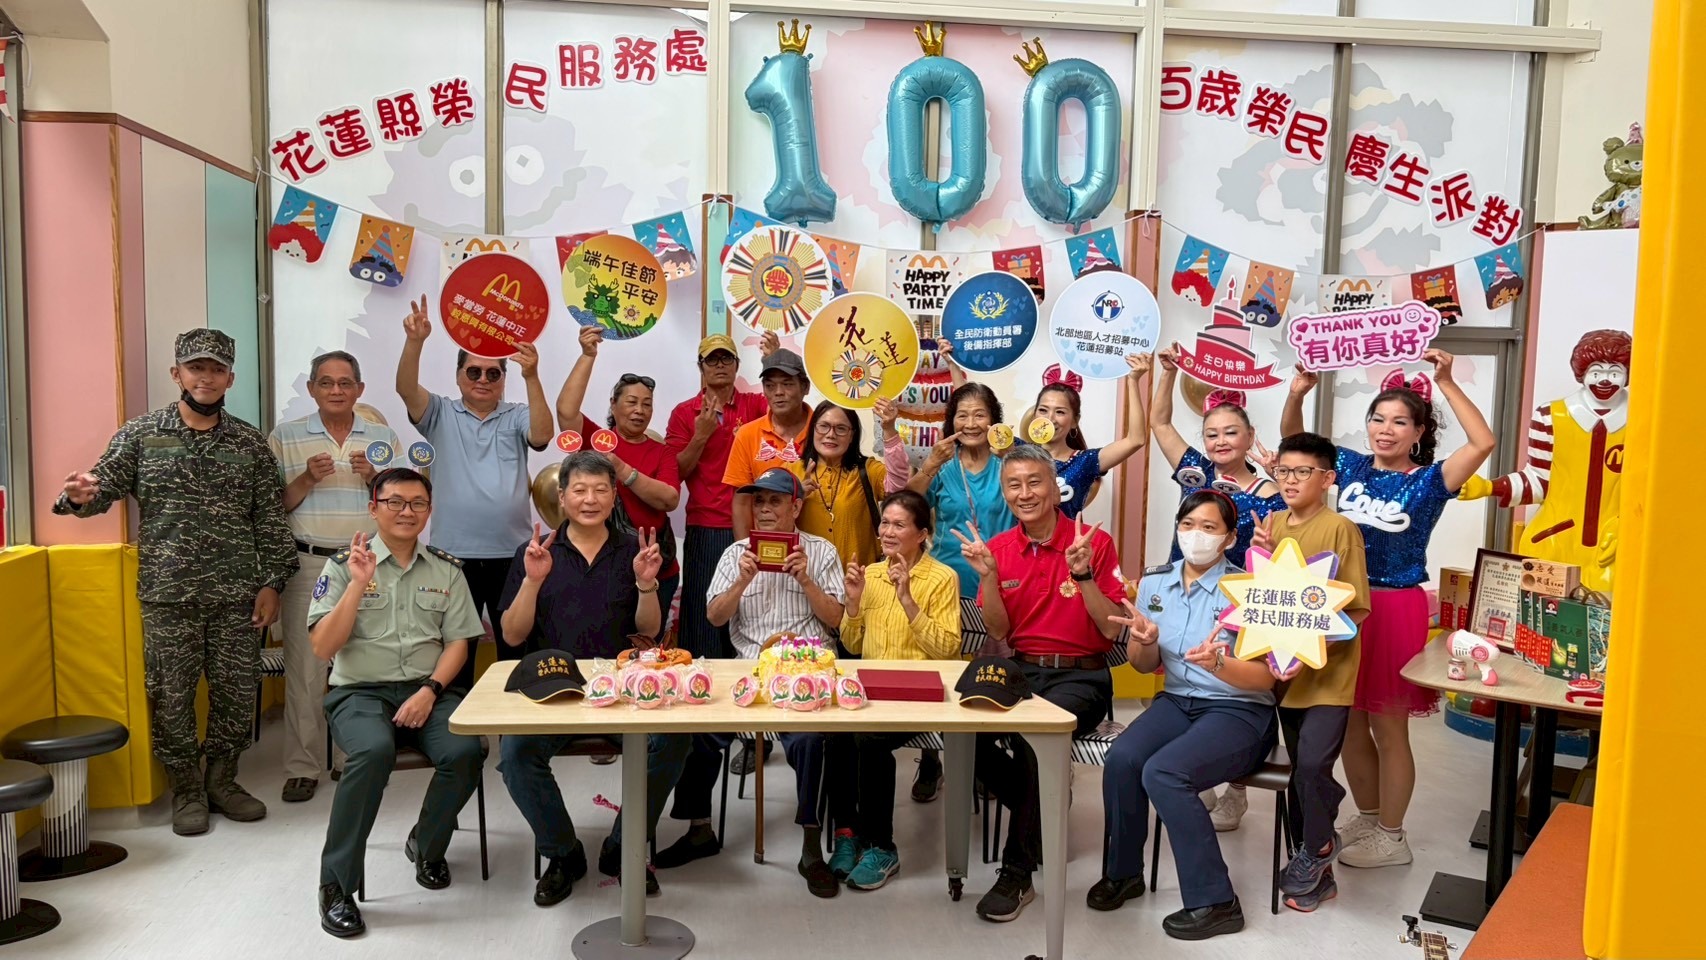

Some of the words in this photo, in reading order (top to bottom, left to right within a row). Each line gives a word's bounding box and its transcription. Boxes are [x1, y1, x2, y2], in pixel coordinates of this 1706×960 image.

[583, 249, 658, 285] 端午佳節
[905, 268, 951, 283] HAPPY
[622, 284, 659, 307] 平安
[903, 283, 951, 297] PARTY
[1334, 292, 1375, 306] HAPPY
[907, 297, 944, 310] TIME
[453, 293, 486, 316] 麥當勞
[486, 310, 527, 337] 花蓮中正
[1312, 320, 1364, 334] THANK
[1368, 312, 1401, 326] YOU
[954, 325, 1022, 340] 全民防衛動員署
[1055, 327, 1150, 348] 北部地區人才招募中心
[963, 338, 1012, 351] 後備指揮部
[1076, 341, 1124, 356] 花蓮招募站
[1303, 328, 1421, 365] 有你真好
[1203, 353, 1246, 372] 生日快樂
[1194, 364, 1222, 384] HAPPY
[1224, 374, 1266, 386] BIRTHDAY
[922, 386, 955, 404] YOU
[1245, 587, 1297, 607] 花蓮縣
[1243, 608, 1331, 631] 榮民服務處
